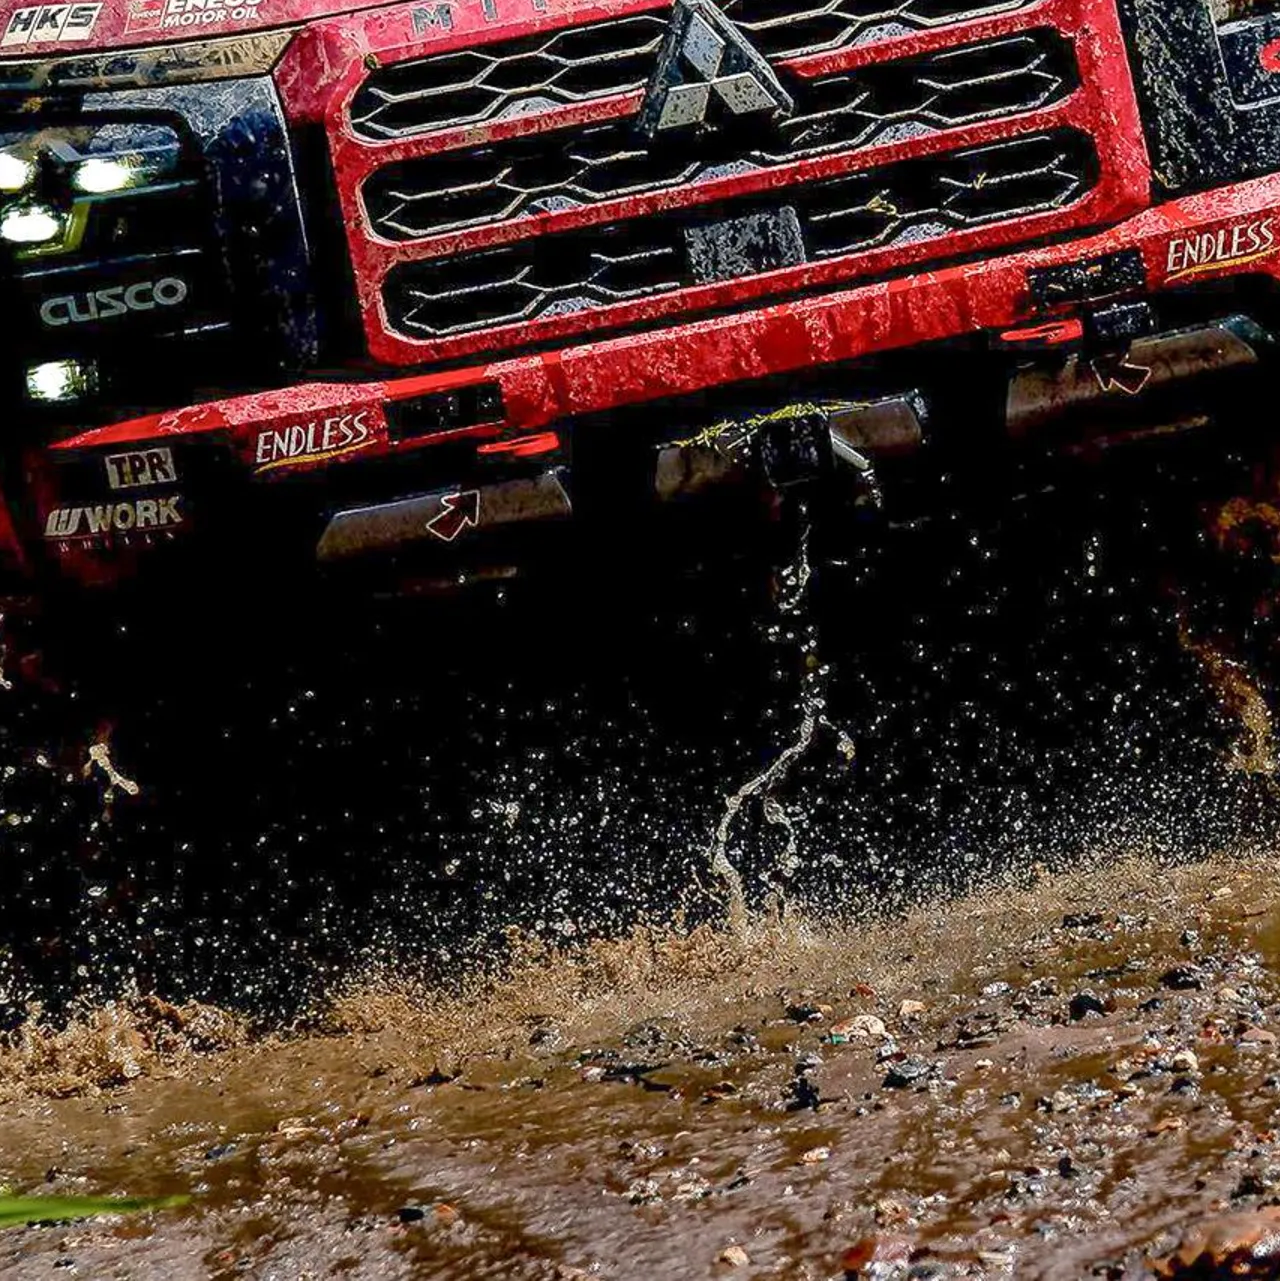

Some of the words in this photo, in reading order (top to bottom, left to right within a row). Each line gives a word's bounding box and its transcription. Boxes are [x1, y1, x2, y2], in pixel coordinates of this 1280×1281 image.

[8, 6, 99, 33] HKS
[164, 9, 226, 28] MOTOR
[231, 6, 259, 20] OIL
[1166, 218, 1276, 273] ENDLESS
[40, 277, 188, 326] CUSCO
[255, 411, 370, 463] ENDLESS
[109, 451, 170, 485] TPR
[84, 495, 183, 534] WORK
